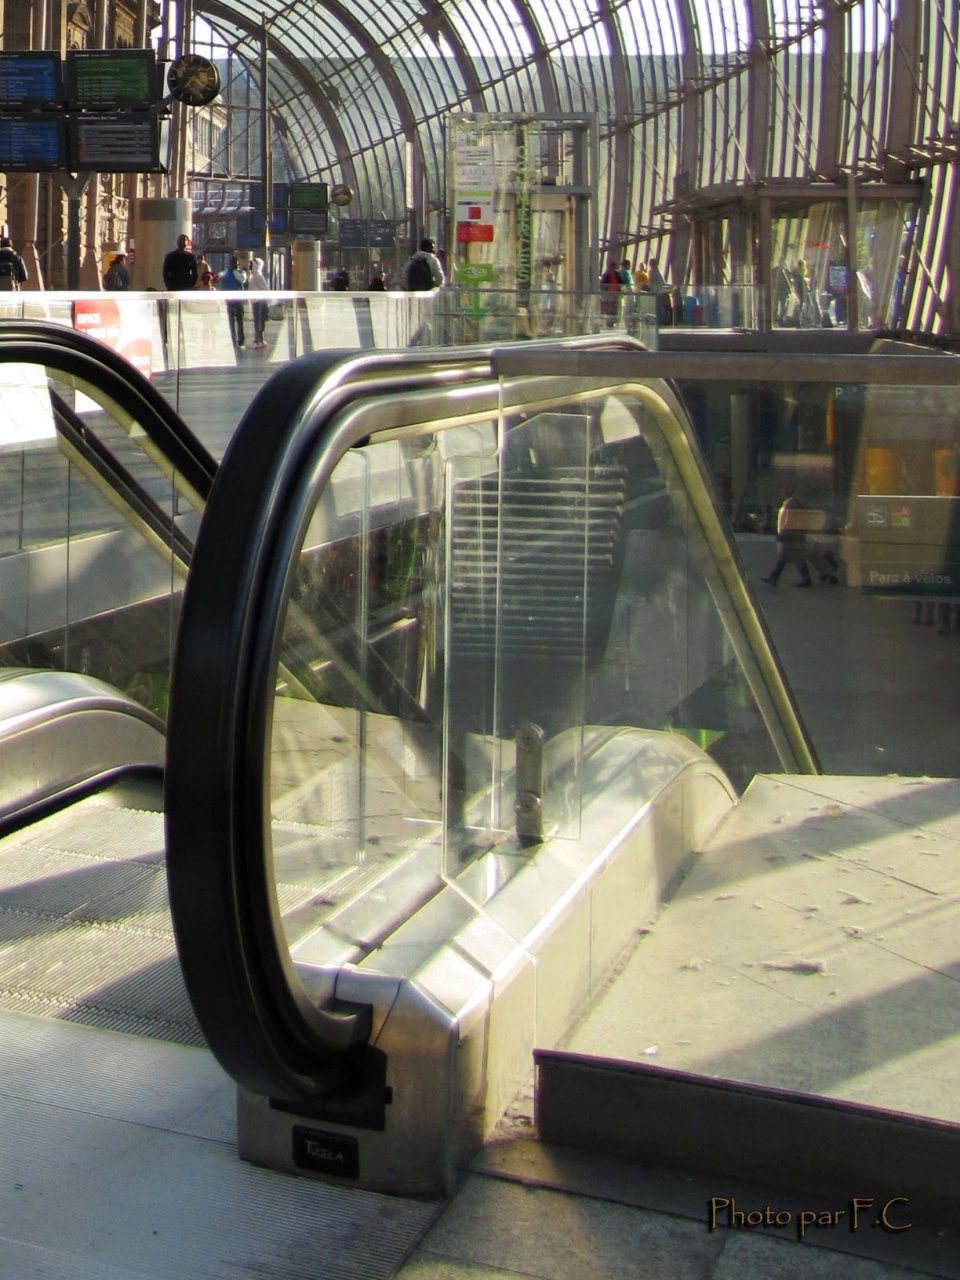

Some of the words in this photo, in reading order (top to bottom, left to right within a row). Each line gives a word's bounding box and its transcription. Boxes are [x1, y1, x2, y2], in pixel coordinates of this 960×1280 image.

[869, 571, 899, 583] Parc
[903, 571, 910, 584] à
[915, 572, 951, 584] vélos
